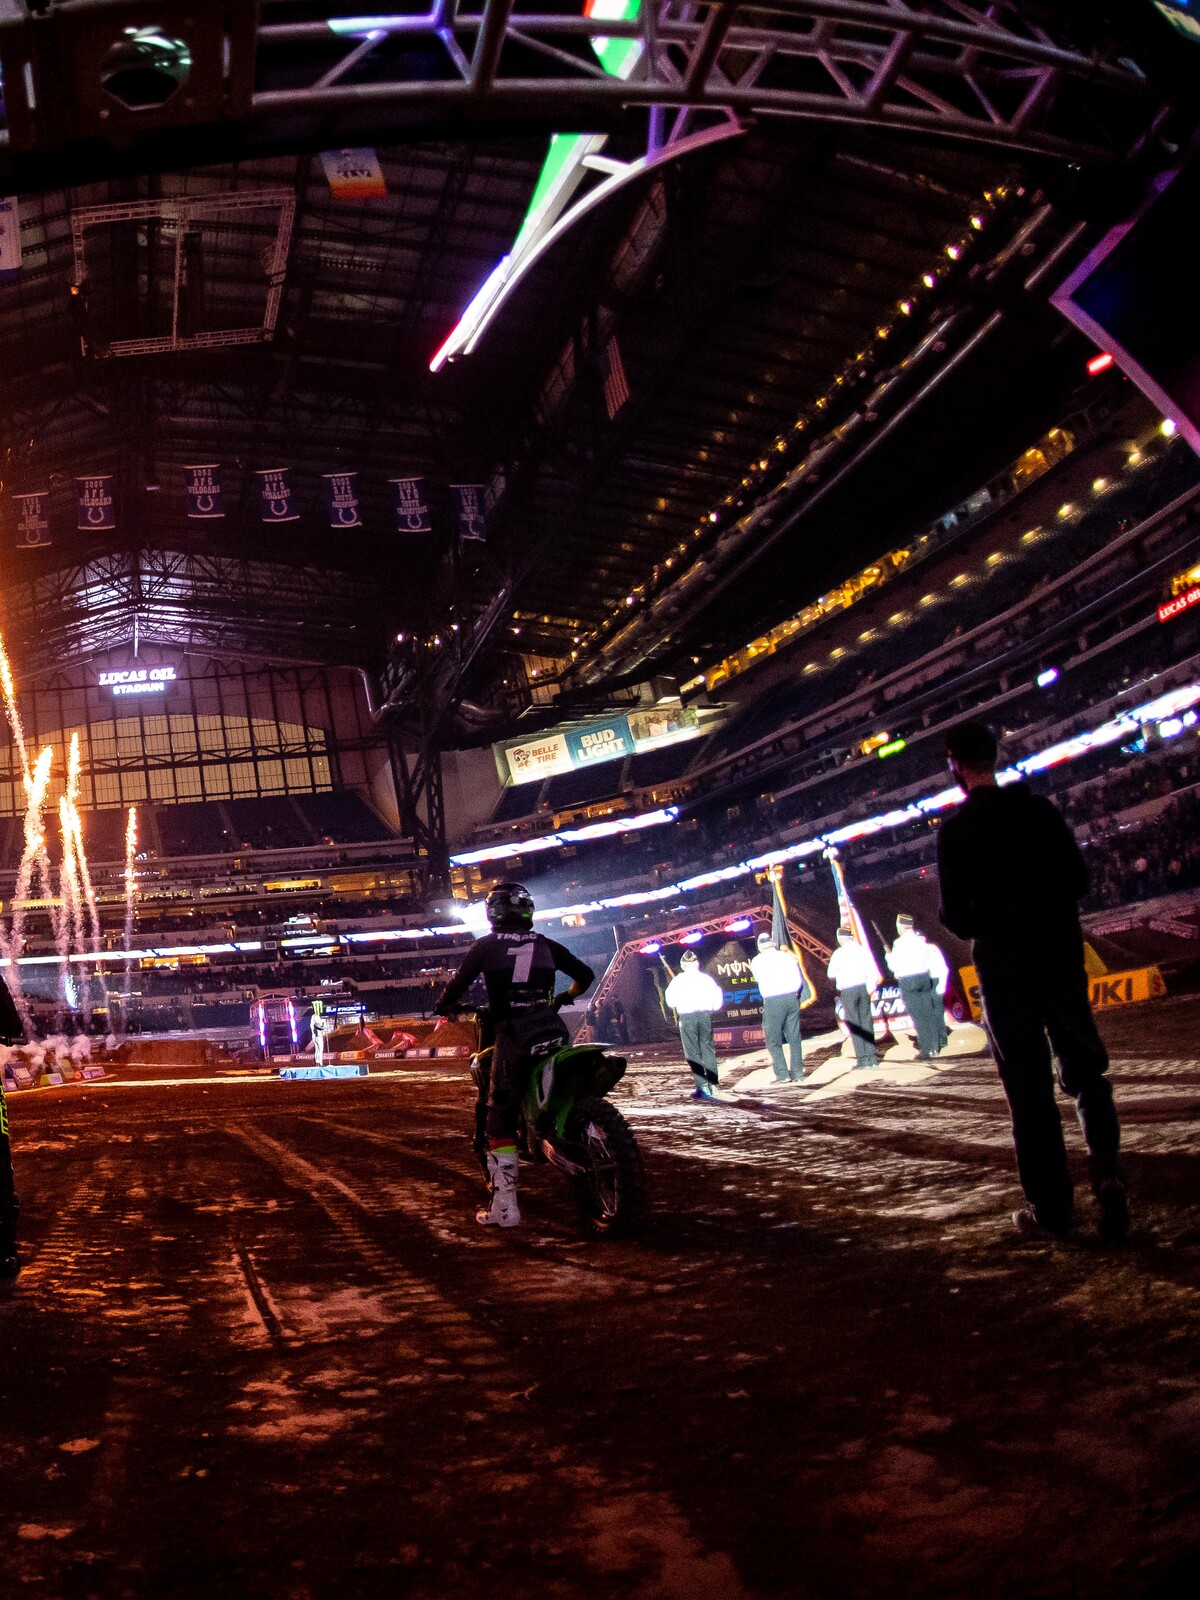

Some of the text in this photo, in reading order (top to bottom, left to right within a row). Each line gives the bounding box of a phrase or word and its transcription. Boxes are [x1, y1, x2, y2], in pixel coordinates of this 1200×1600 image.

[1160, 597, 1187, 619] LUCAS
[98, 667, 177, 686] LUCAS OIL
[112, 682, 165, 695] STADIUM
[580, 728, 616, 748] BUD
[531, 743, 559, 757] BELLE
[536, 752, 557, 764] TIRE
[577, 737, 625, 761] LIGHT
[506, 942, 535, 983] 1
[727, 1009, 739, 1018] FIM
[740, 1008, 758, 1016] World
